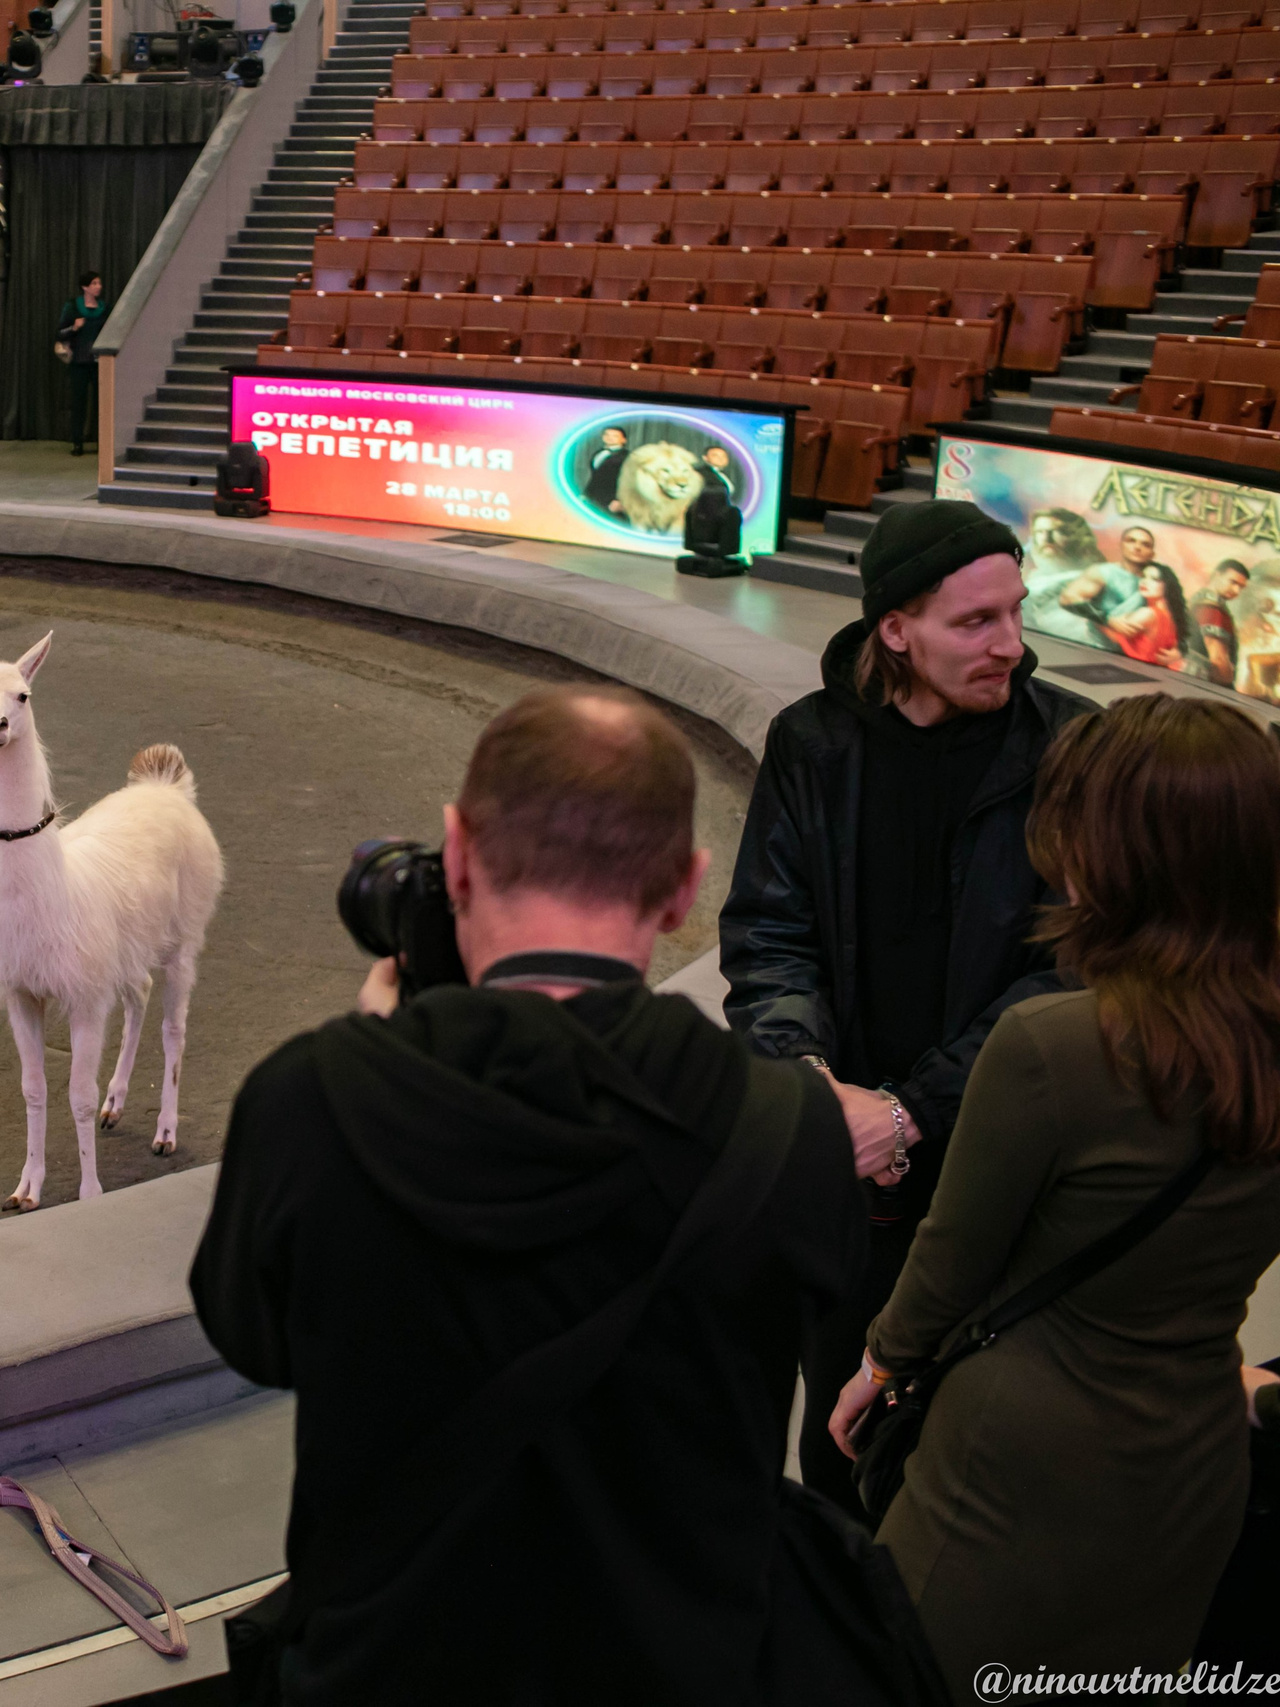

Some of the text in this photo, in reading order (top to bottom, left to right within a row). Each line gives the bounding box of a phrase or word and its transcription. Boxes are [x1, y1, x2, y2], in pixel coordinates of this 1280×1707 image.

[254, 384, 514, 410] БОЛЬШОЙ МОСКОВСКИЙ ЦИРК
[251, 411, 413, 436] ОТКРЫТАЯ
[251, 430, 514, 471] РЕПЕТИЦИЯ
[385, 481, 510, 506] 28 МАРТА
[442, 502, 511, 522] 18:00
